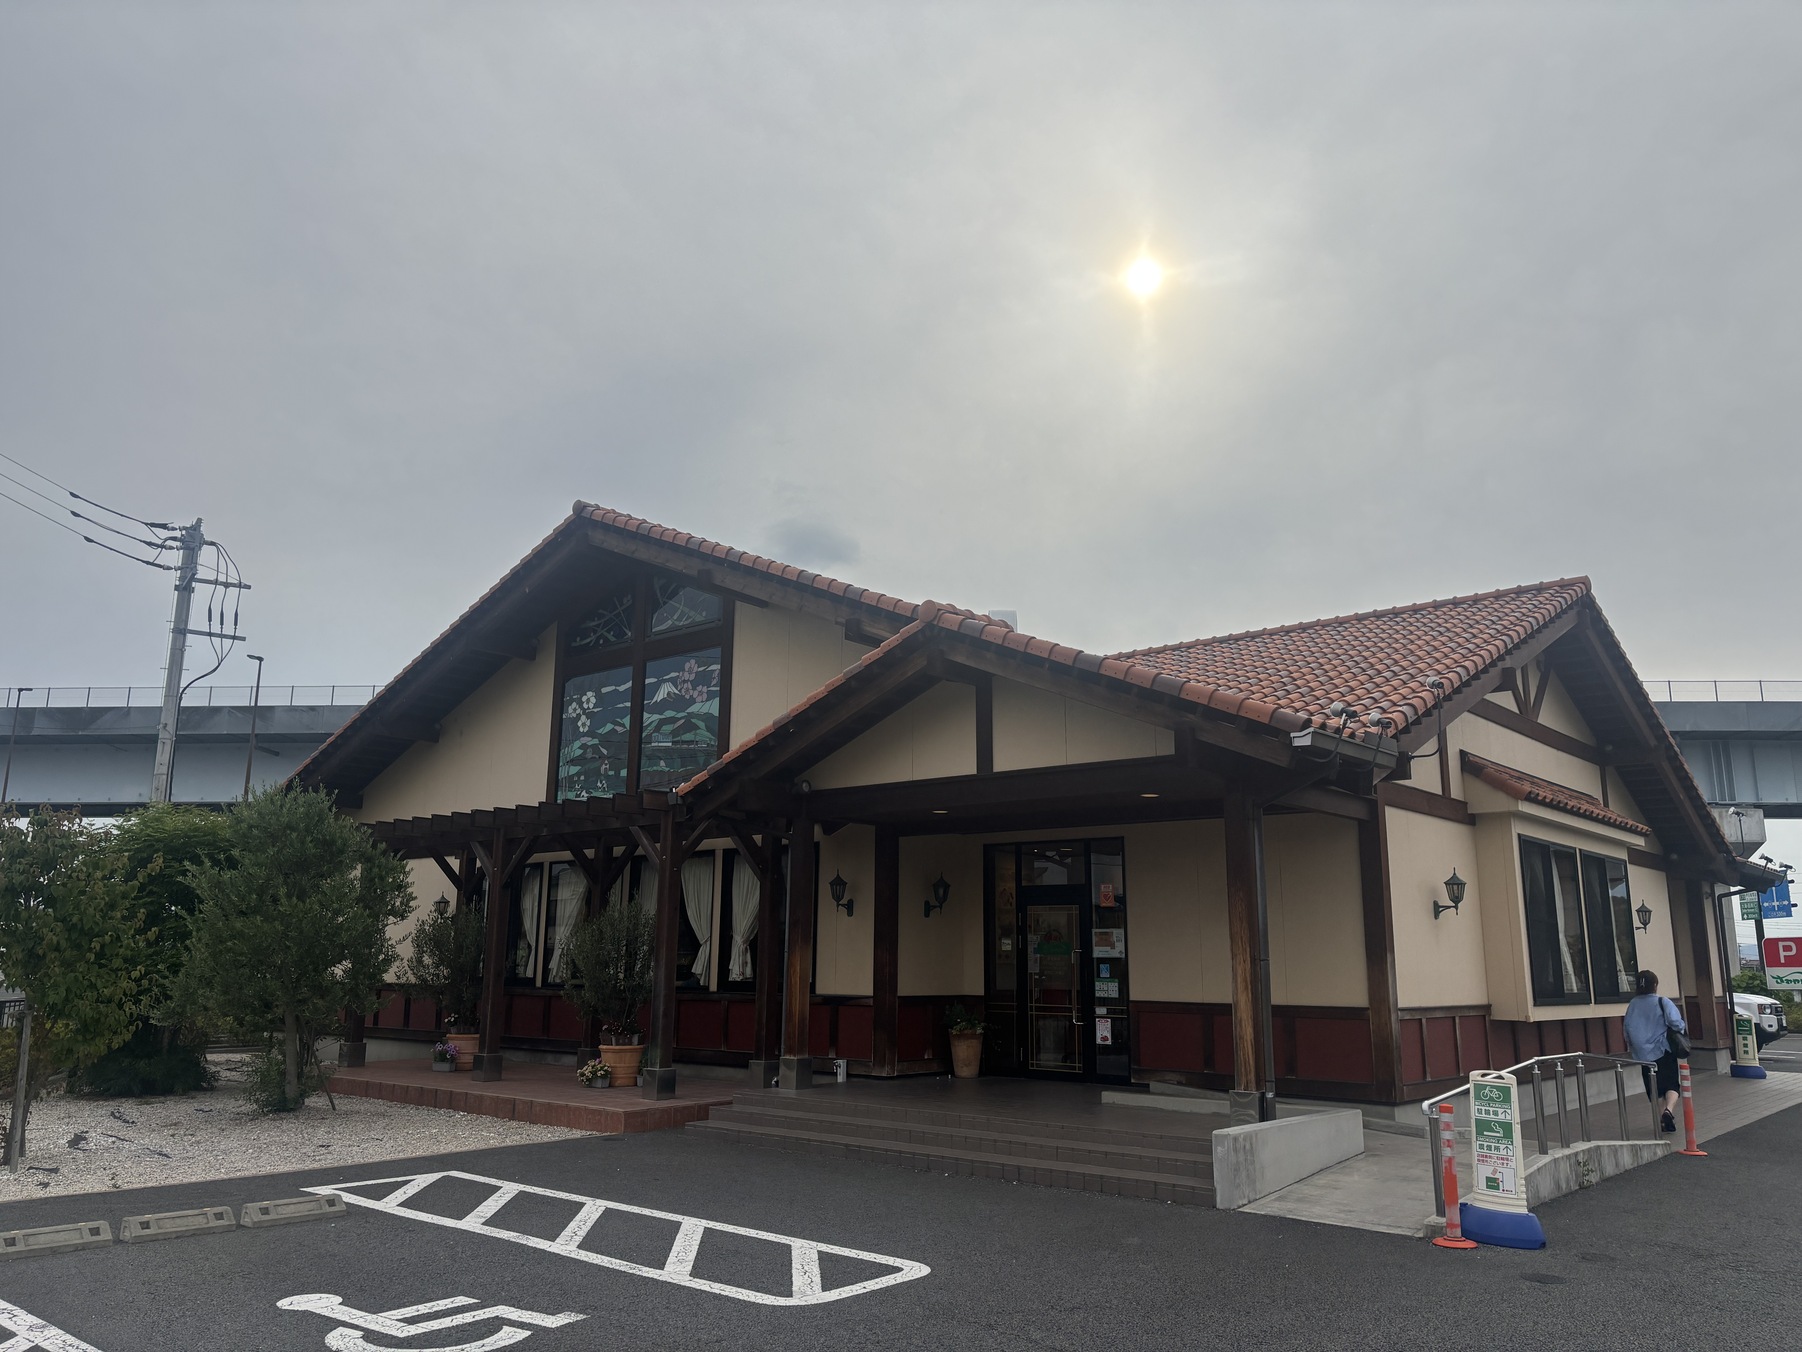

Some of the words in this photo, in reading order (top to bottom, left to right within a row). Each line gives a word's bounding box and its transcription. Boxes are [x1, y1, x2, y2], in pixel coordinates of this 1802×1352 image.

[1778, 941, 1797, 963] P
[1476, 1107, 1499, 1117] 駐輪場
[1478, 1143, 1501, 1153] 喫煙所
